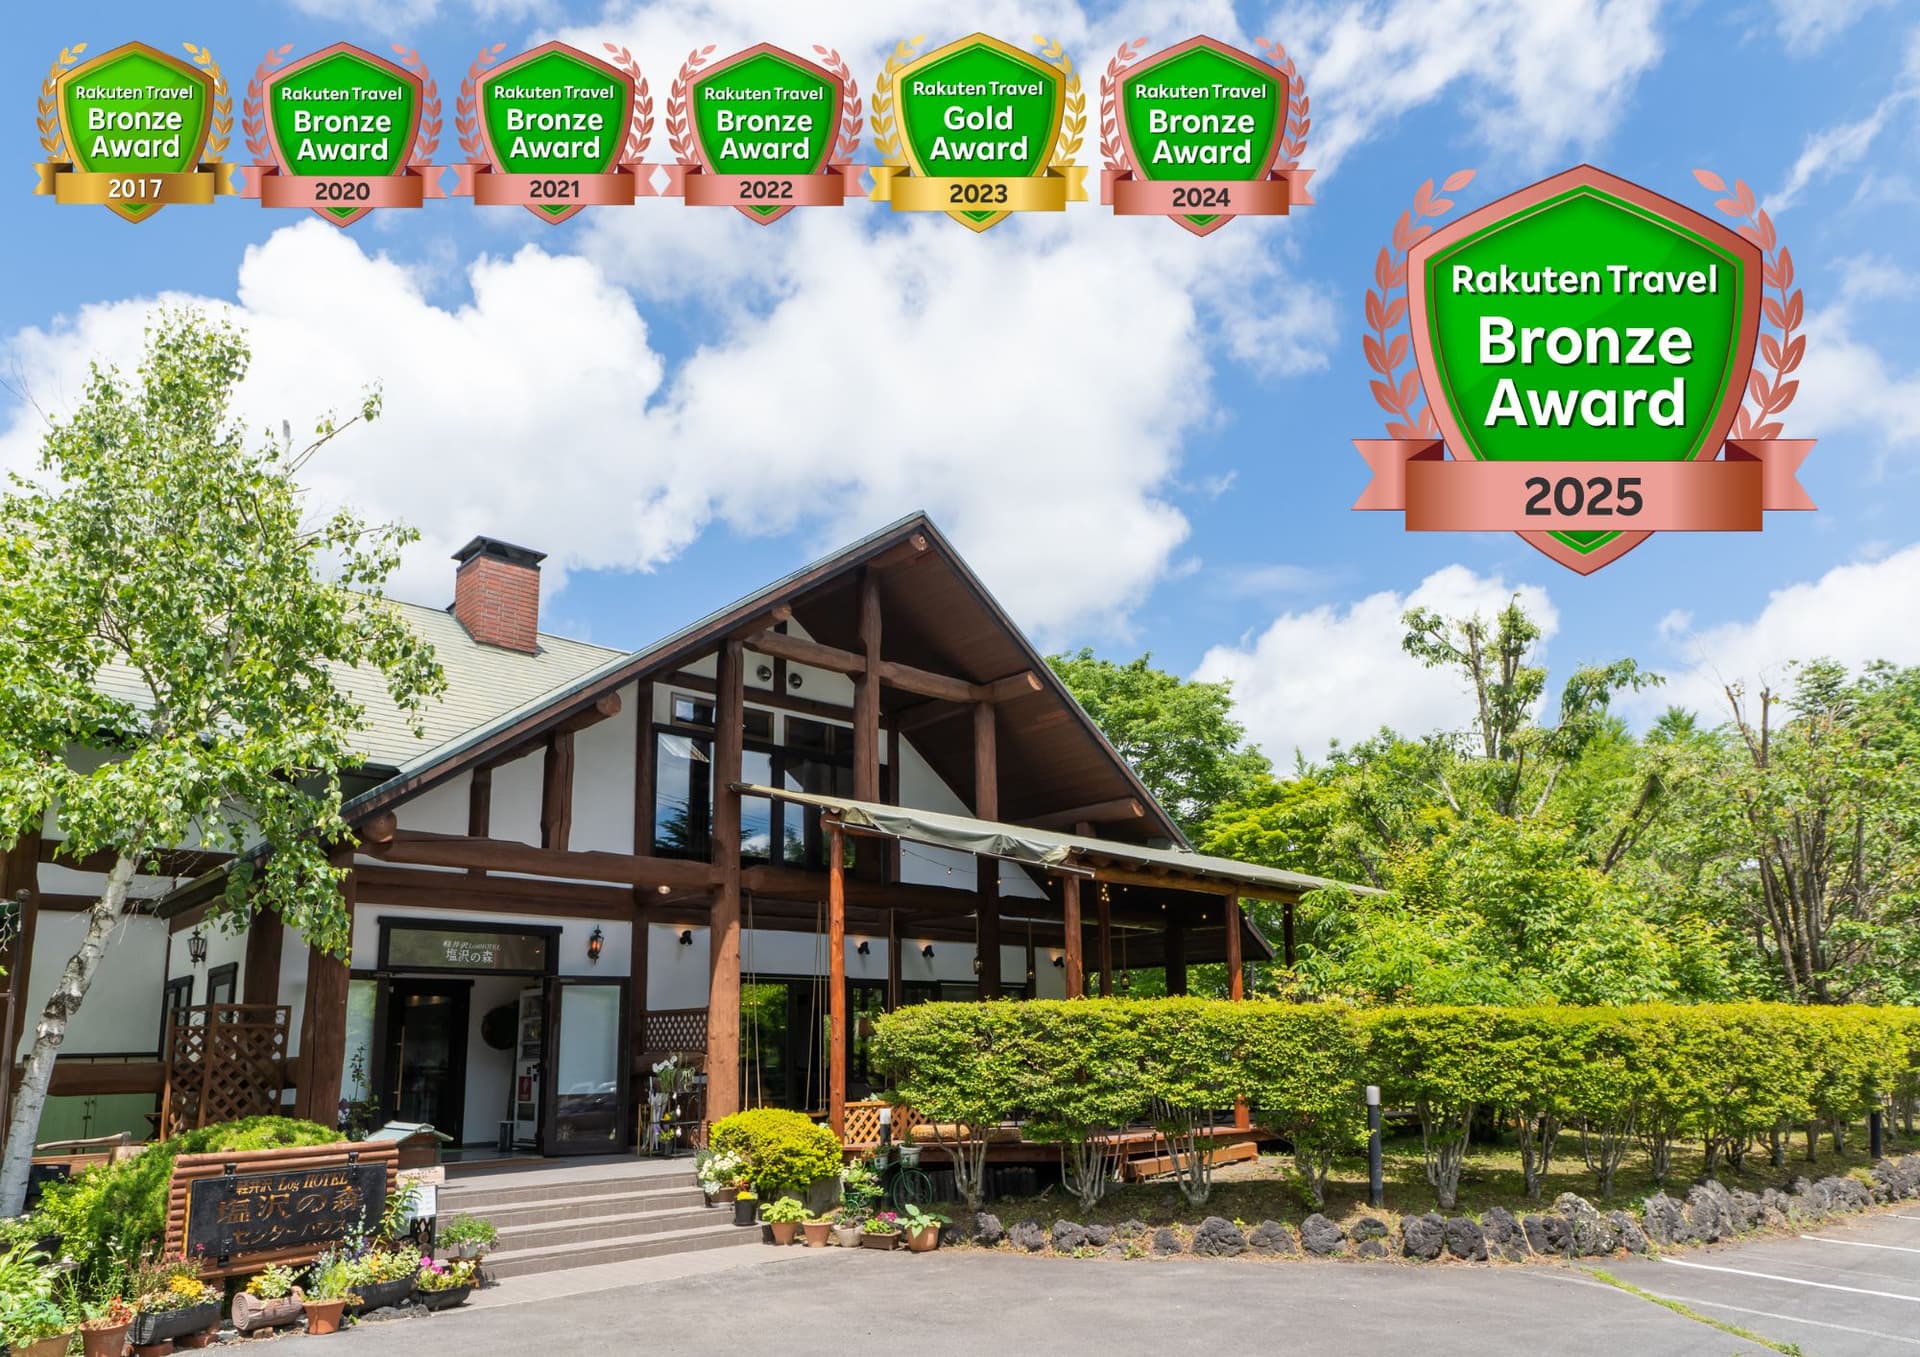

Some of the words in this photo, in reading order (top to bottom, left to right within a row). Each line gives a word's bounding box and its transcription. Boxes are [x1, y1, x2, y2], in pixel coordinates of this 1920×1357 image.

[236, 1180, 273, 1195] 軽井沢
[303, 1172, 348, 1189] HOTEL
[216, 1185, 364, 1224] 塩沢の森
[233, 1219, 348, 1245] センターハウス
